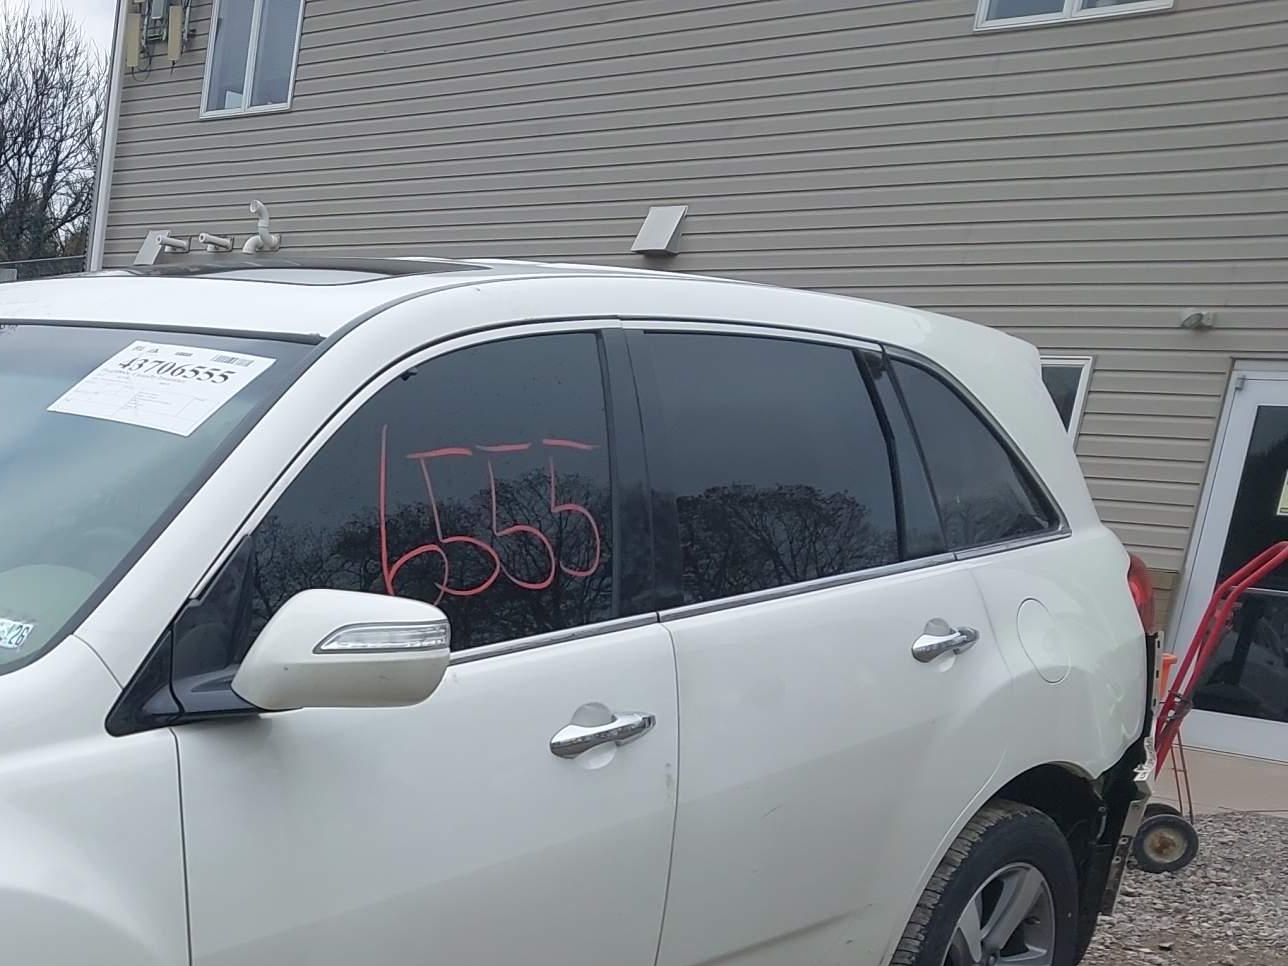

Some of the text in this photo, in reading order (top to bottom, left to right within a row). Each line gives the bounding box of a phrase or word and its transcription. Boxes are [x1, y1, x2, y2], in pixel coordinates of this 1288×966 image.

[118, 357, 237, 384] 43706555
[380, 423, 601, 606] 6555
[8, 624, 30, 646] 26
